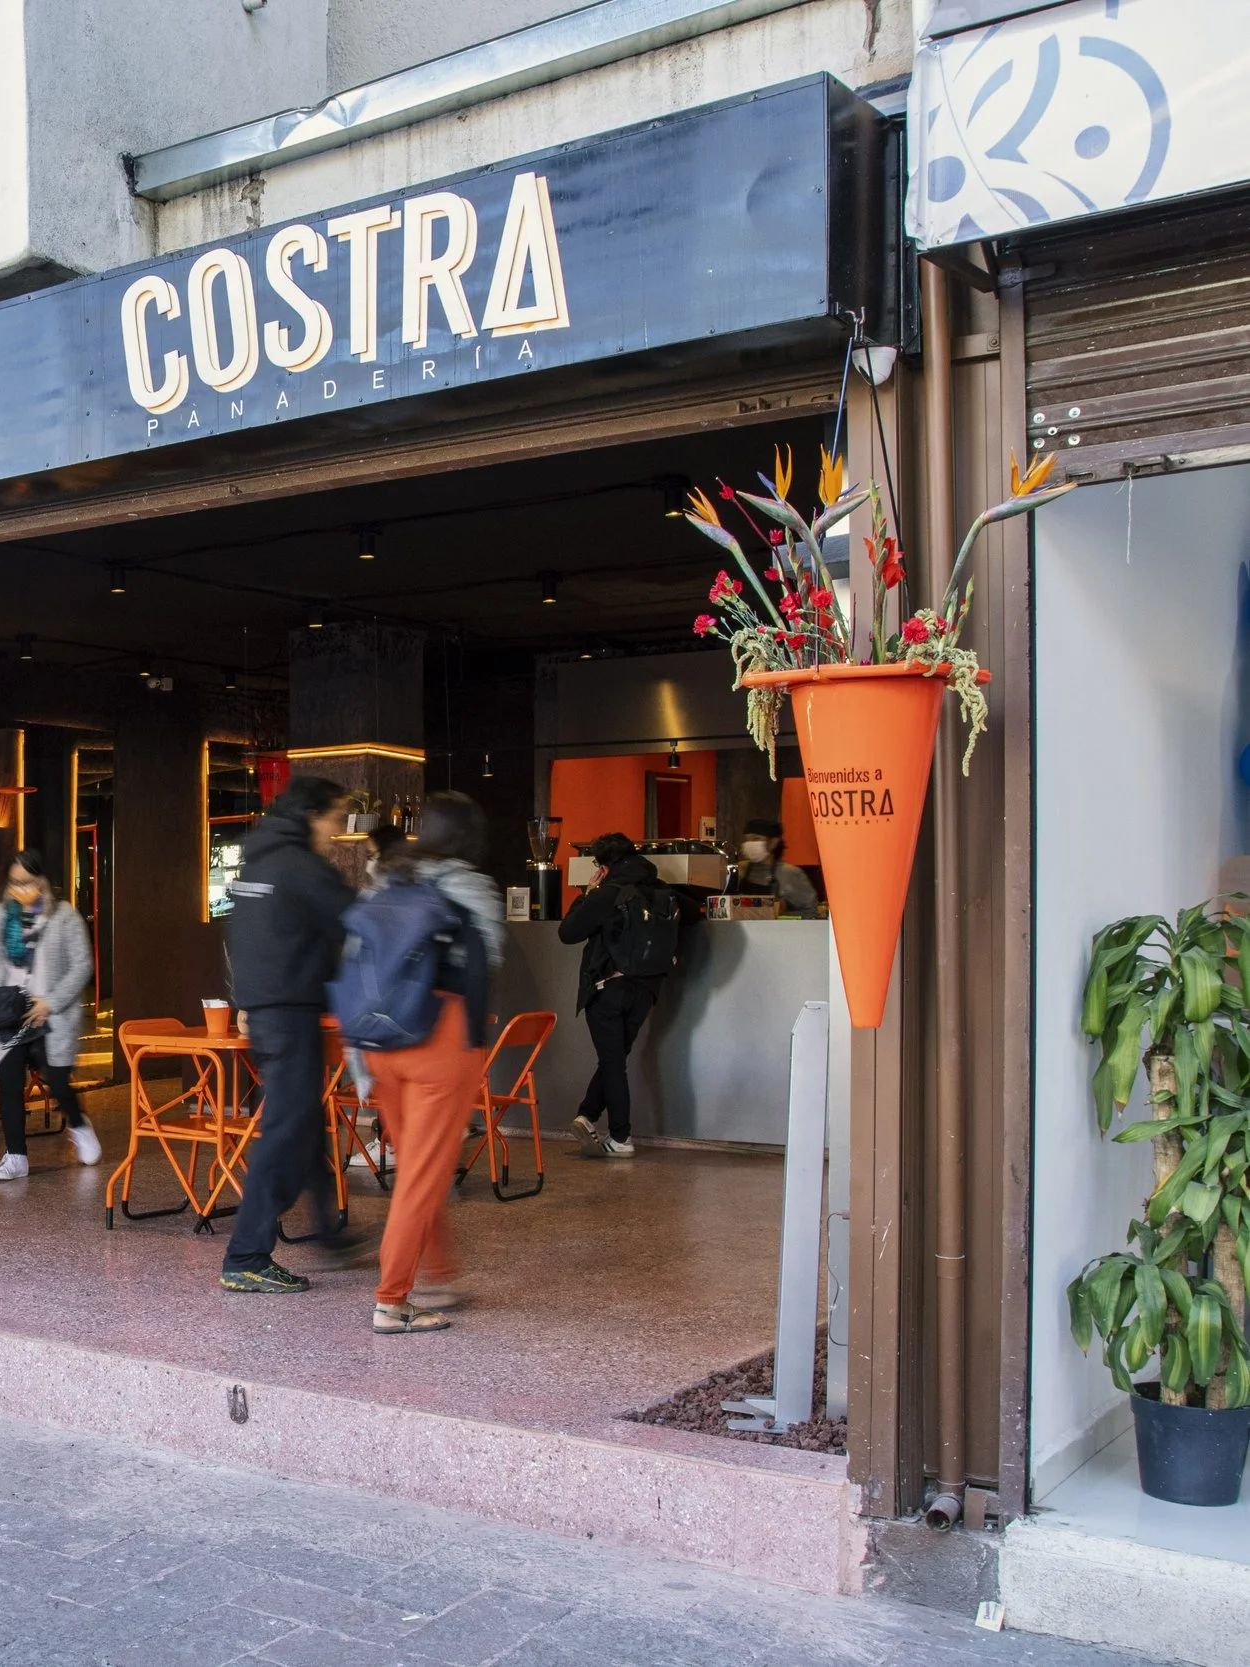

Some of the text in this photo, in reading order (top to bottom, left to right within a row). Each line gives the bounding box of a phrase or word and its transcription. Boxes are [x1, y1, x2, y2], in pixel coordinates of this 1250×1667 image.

[120, 171, 570, 415] COSTRA
[147, 338, 534, 437] PANADERÍA
[807, 767, 883, 783] Bienvenidxs a
[810, 788, 894, 818] COSTRA
